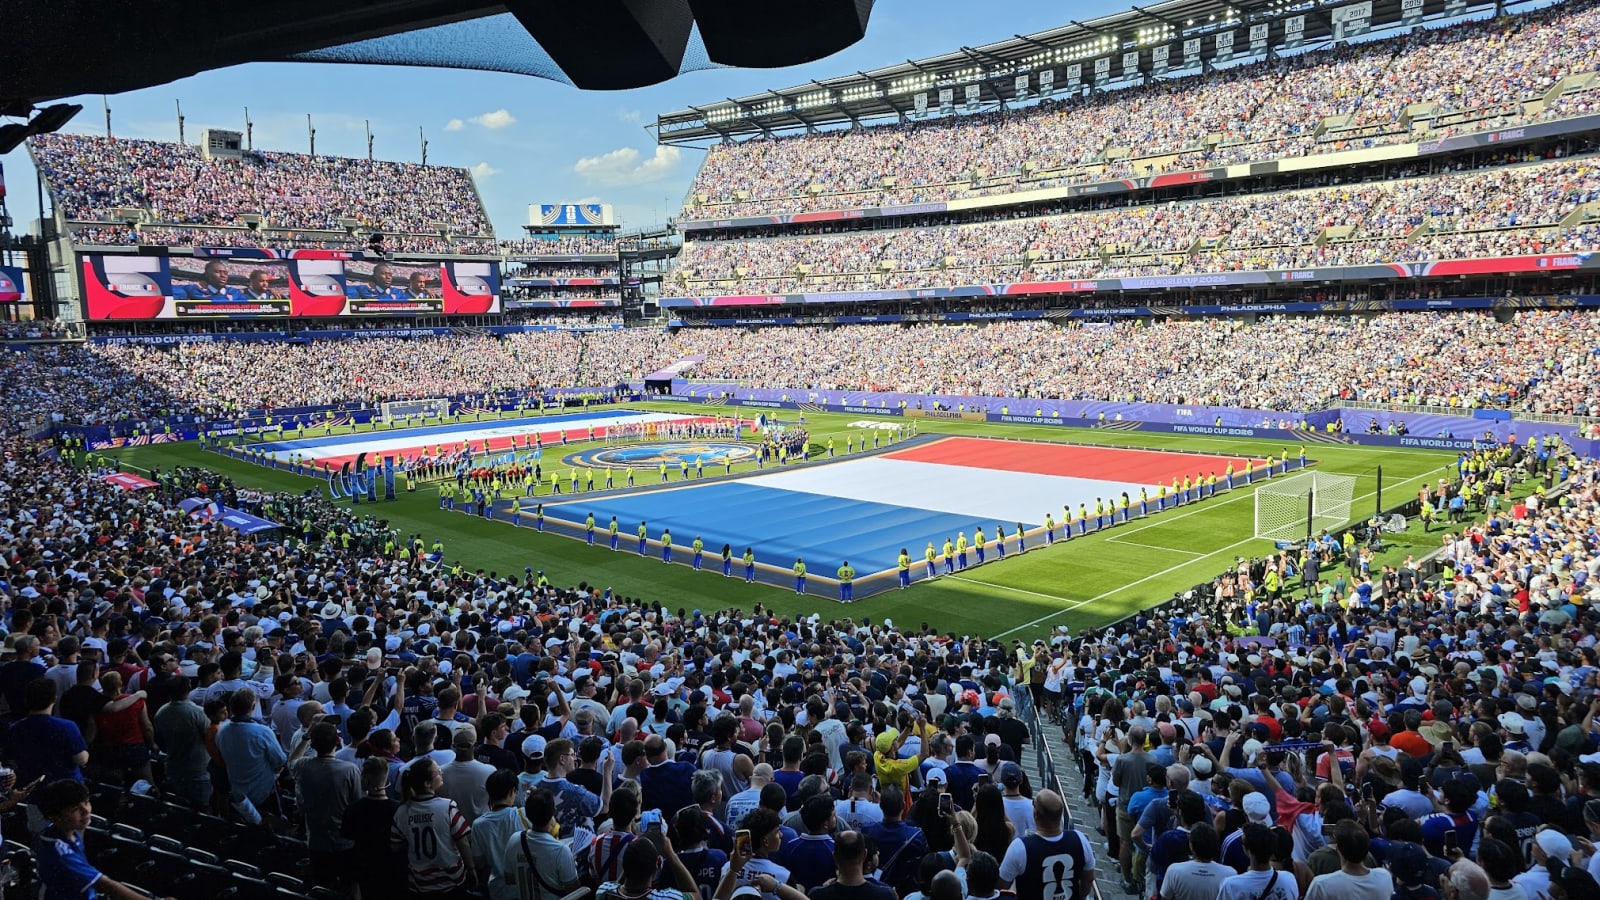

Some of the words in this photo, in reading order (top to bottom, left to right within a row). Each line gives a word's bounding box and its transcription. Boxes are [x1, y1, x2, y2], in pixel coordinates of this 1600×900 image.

[1350, 8, 1366, 18] 2017
[1499, 129, 1525, 141] FRANCE
[1552, 256, 1583, 267] FRANCE
[1291, 271, 1315, 279] FRANCE
[1220, 304, 1286, 312] PHILADELPHIA
[925, 411, 962, 419] PHILADELPHIA
[1400, 438, 1420, 446] FIFA
[1420, 439, 1452, 448] WORLD
[1454, 441, 1472, 449] CUP
[408, 812, 434, 825] PULISIC
[411, 826, 438, 860] 10
